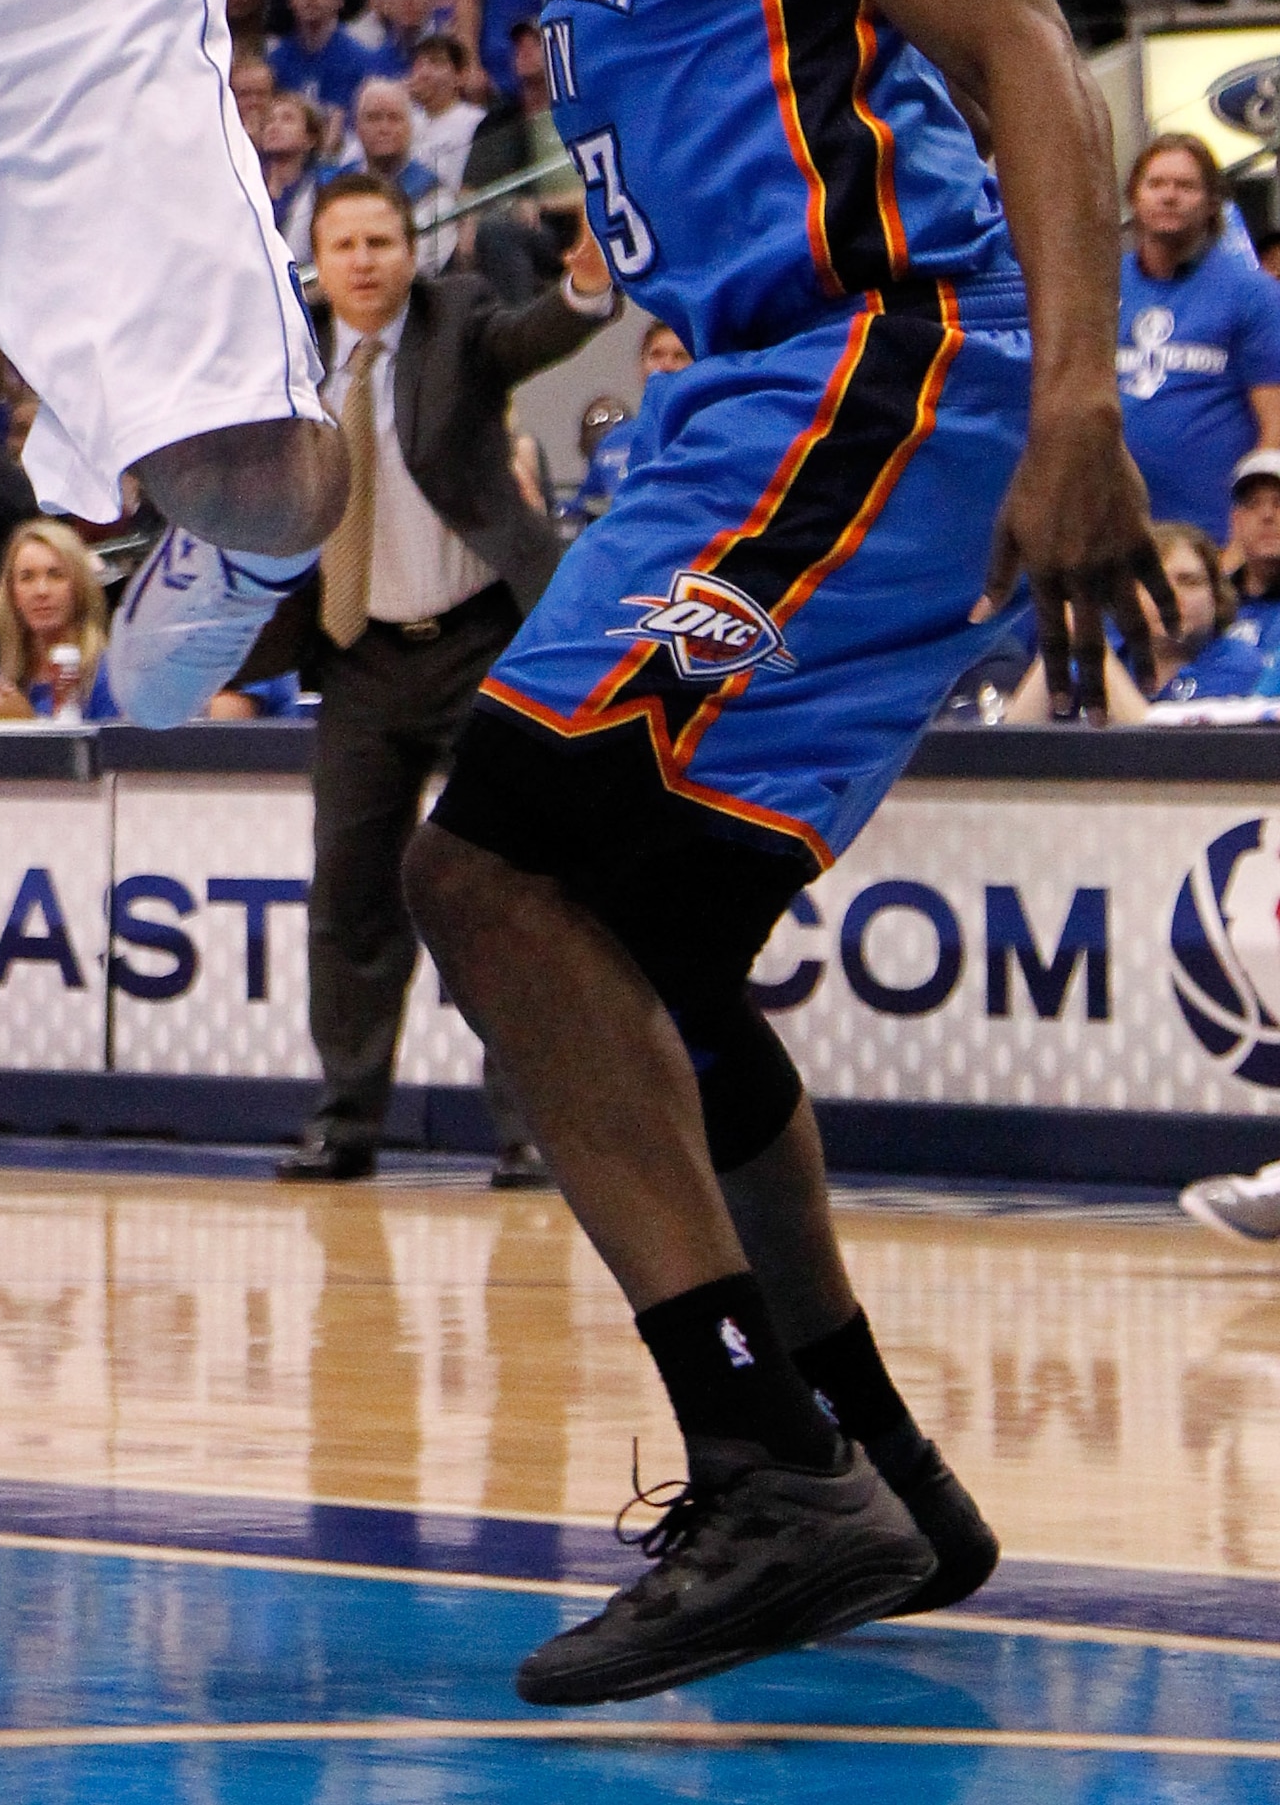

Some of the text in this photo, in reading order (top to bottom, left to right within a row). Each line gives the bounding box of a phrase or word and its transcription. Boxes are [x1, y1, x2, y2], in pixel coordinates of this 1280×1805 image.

[570, 131, 655, 278] 3
[646, 599, 759, 647] OKC
[748, 878, 1113, 1022] COM
